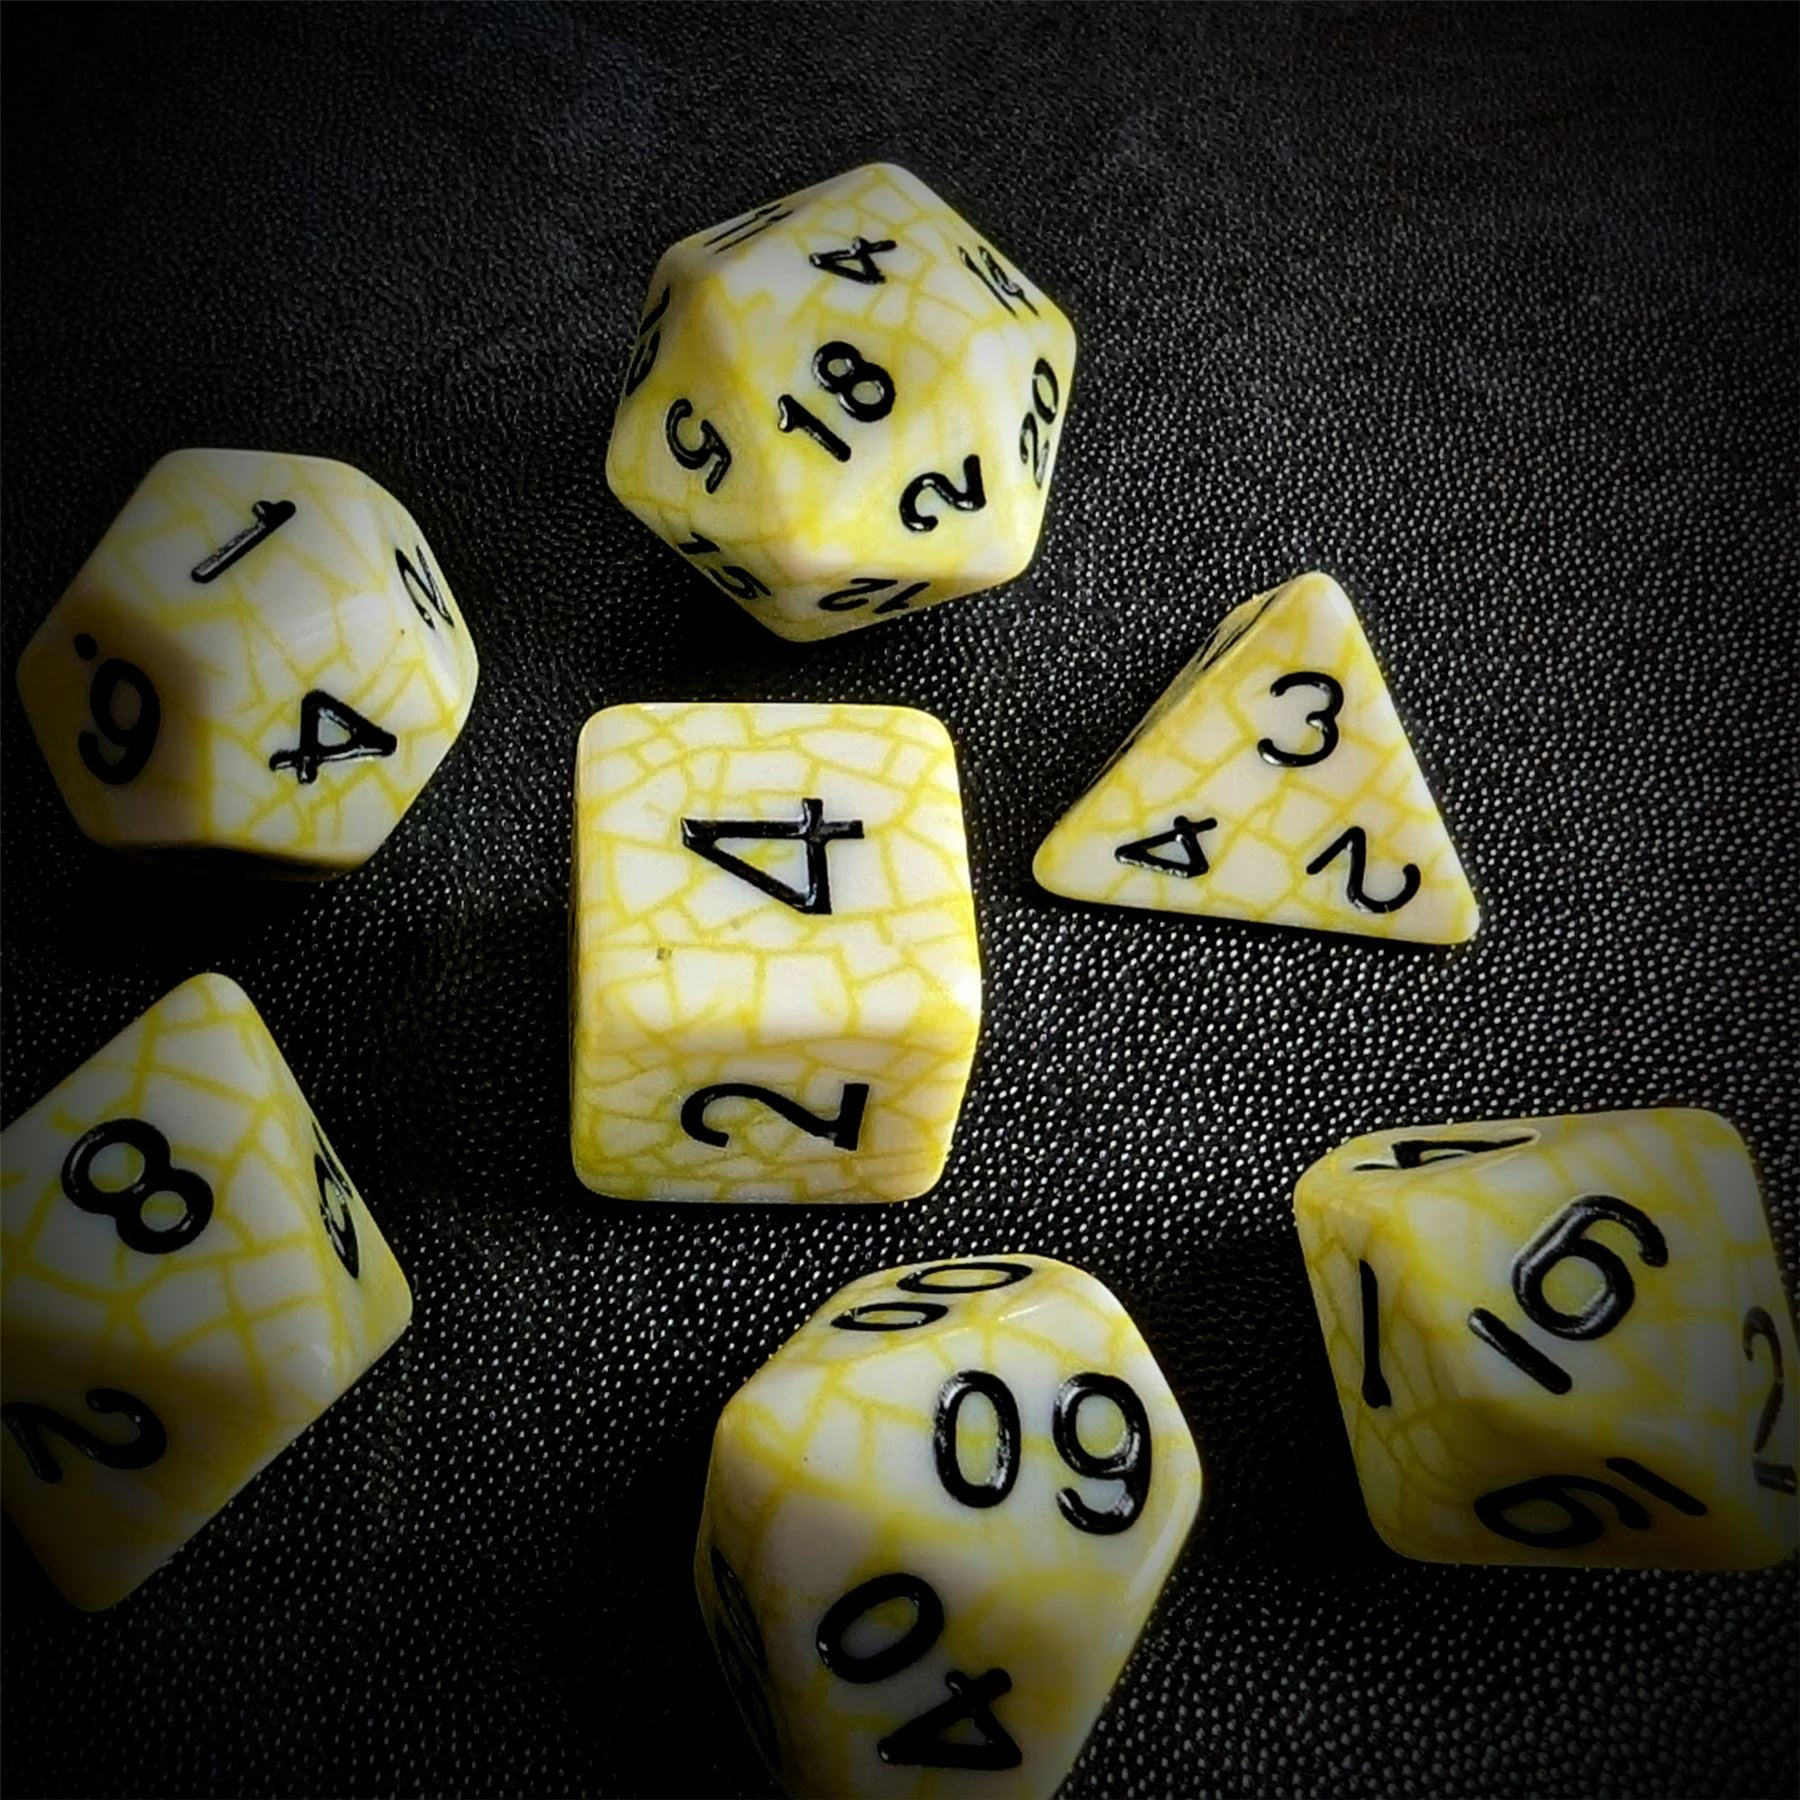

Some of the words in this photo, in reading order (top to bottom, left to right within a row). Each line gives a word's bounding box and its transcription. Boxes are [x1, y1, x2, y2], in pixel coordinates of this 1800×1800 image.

[810, 237, 896, 284] 4
[666, 398, 731, 494] 5
[778, 341, 896, 462] 18
[1019, 358, 1059, 490] 20
[900, 454, 987, 532] 2
[191, 500, 296, 583] 1
[395, 545, 455, 630] 2
[679, 532, 771, 598] 15
[819, 578, 930, 614] 12
[269, 689, 397, 784] 4
[1257, 671, 1344, 767] 3
[681, 798, 865, 914] 4
[1115, 816, 1217, 878] 4
[1306, 826, 1421, 913] 2
[680, 1083, 870, 1151] 2
[61, 1117, 214, 1255] 8
[831, 1262, 1033, 1331] 00
[1359, 1258, 1392, 1409] 1
[0, 1387, 168, 1484] 2
[1743, 1307, 1798, 1495] 2
[815, 1572, 1022, 1770] 40
